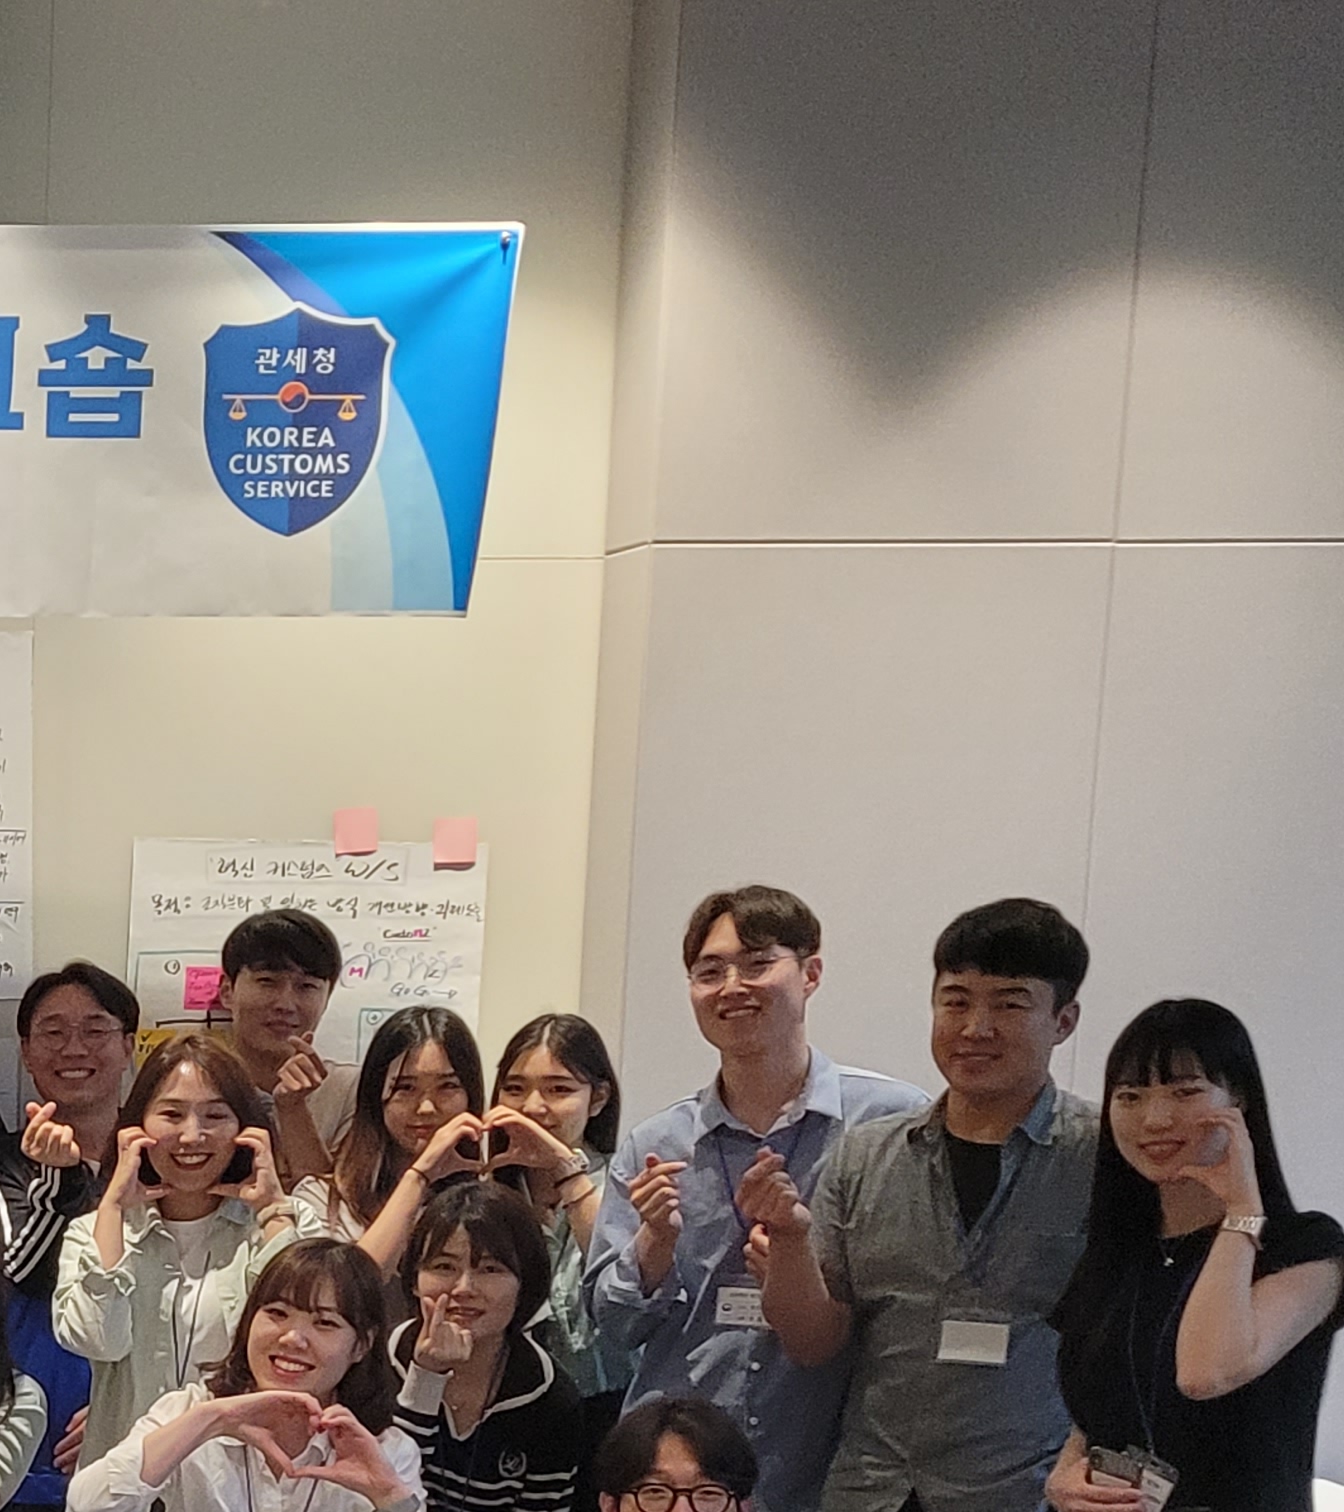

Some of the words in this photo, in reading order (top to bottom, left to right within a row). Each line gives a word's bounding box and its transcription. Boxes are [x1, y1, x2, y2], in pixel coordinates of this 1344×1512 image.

[253, 345, 339, 376] 관세청
[244, 425, 338, 452] KOREA
[226, 449, 352, 477] CUSTOMS
[242, 477, 336, 501] SERVICE
